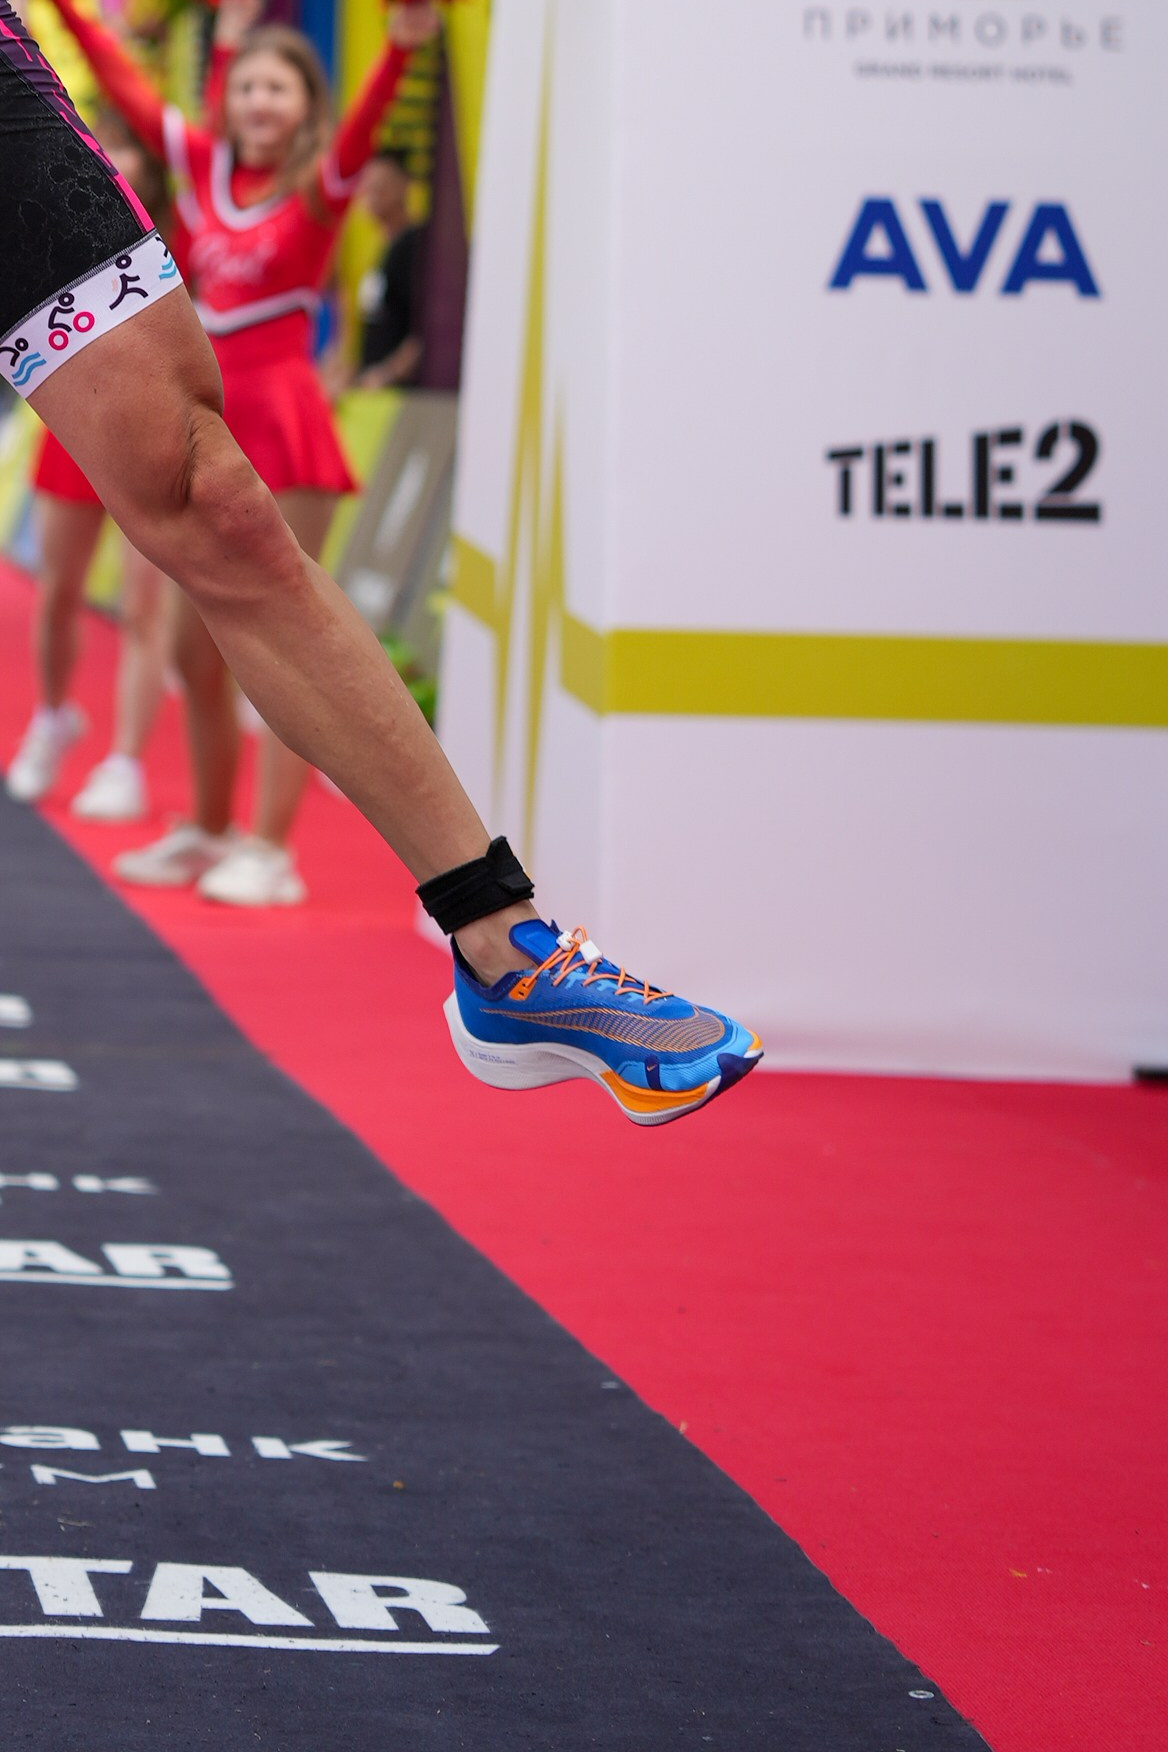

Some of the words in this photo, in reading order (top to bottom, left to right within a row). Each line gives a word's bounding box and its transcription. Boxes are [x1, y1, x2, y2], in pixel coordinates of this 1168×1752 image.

[803, 6, 1126, 52] ПРИМОРЬЕ
[827, 195, 1102, 298] AVA
[826, 418, 1102, 524] TELE2
